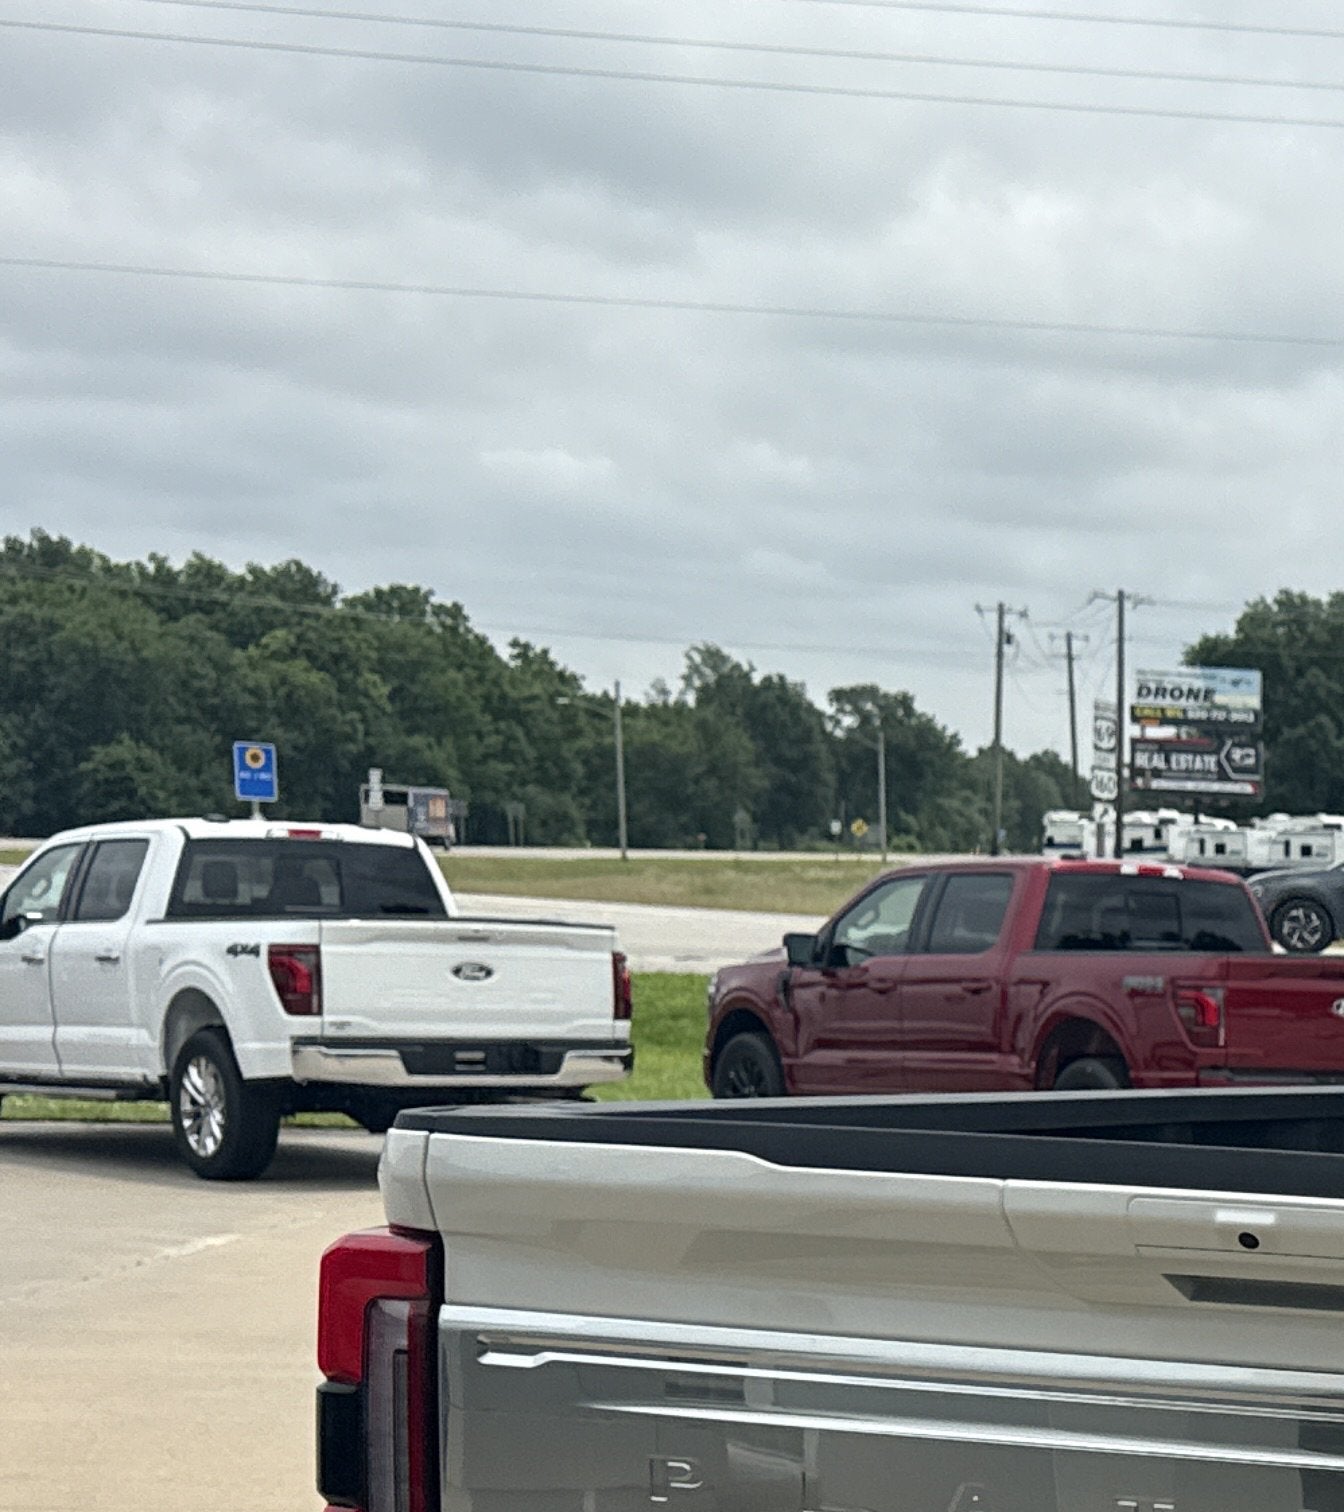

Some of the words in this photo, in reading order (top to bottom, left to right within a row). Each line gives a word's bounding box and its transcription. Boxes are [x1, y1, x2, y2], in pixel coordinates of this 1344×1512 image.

[1137, 683, 1217, 702] DRONE
[1134, 751, 1168, 770] REAL
[1170, 752, 1219, 772] ESTATE
